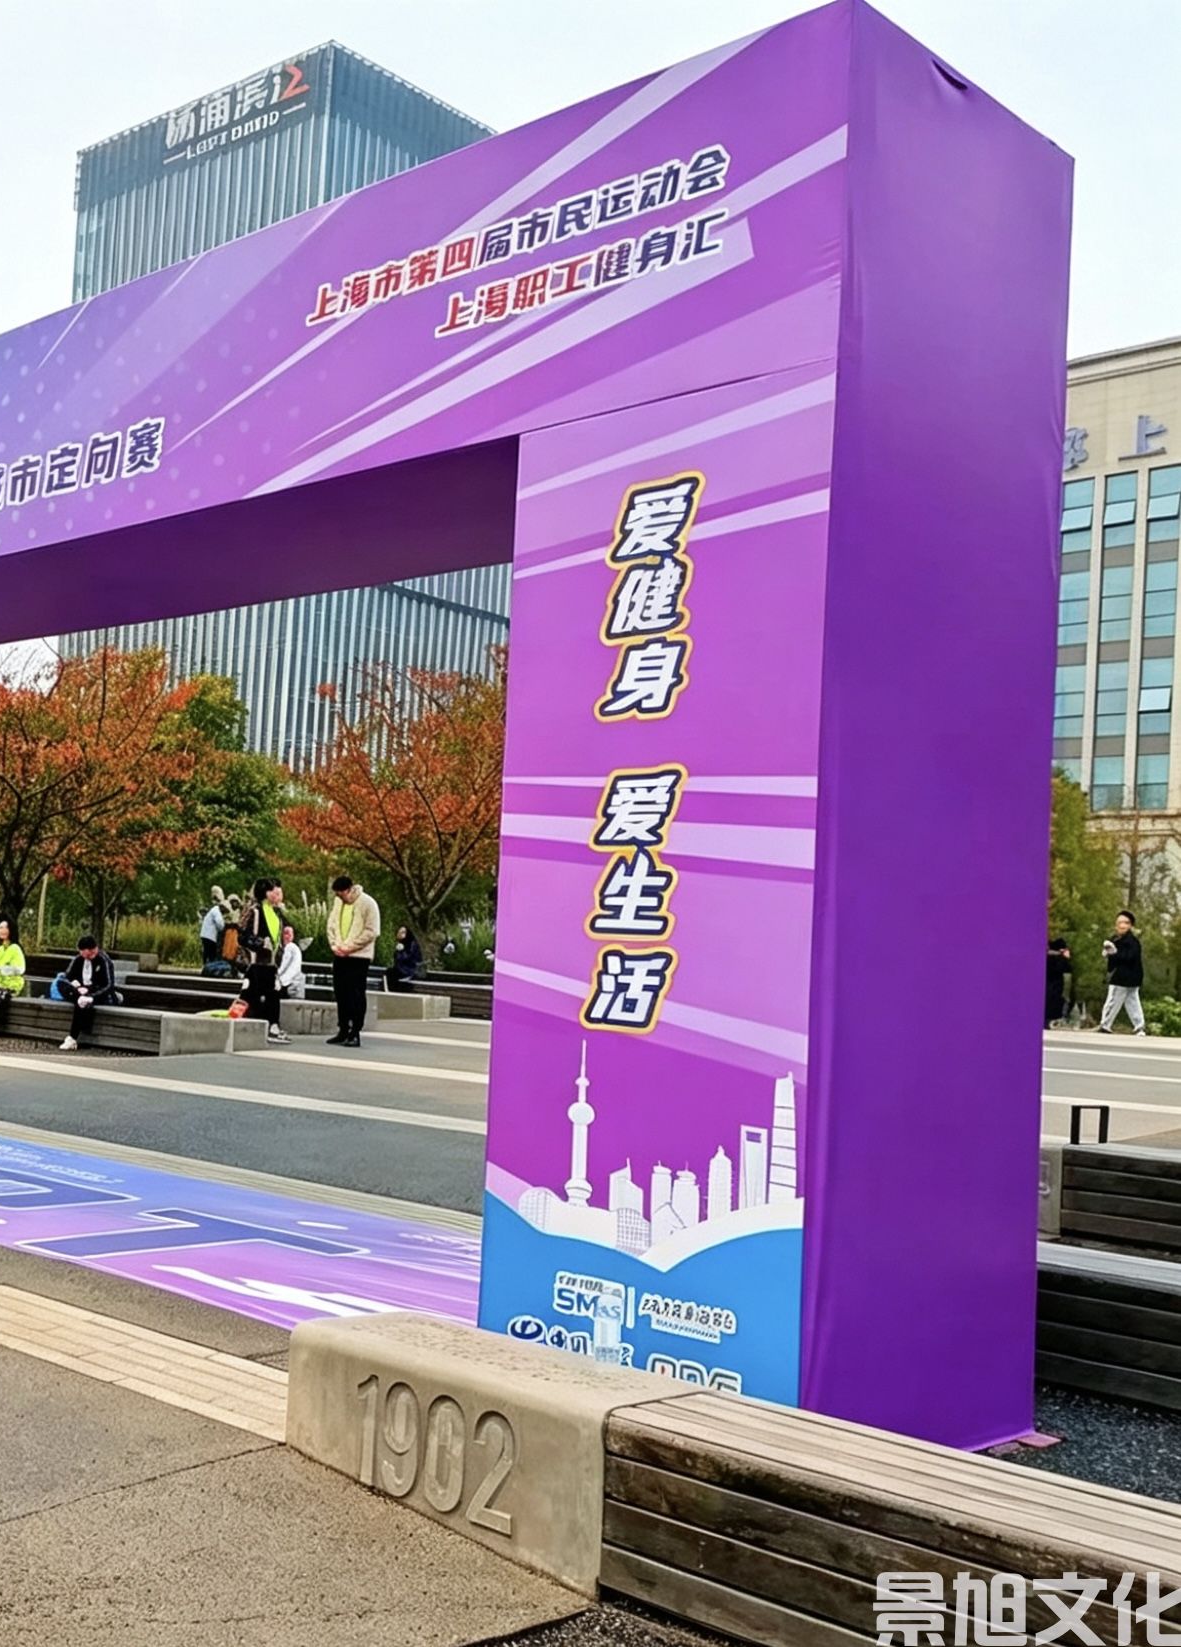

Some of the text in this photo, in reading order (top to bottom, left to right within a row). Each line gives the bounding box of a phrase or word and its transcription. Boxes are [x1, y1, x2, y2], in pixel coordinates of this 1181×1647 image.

[306, 144, 731, 326] 上海市第四届市民运动会
[582, 474, 702, 1031] 爱健身 爱生活
[357, 1374, 516, 1538] 1902
